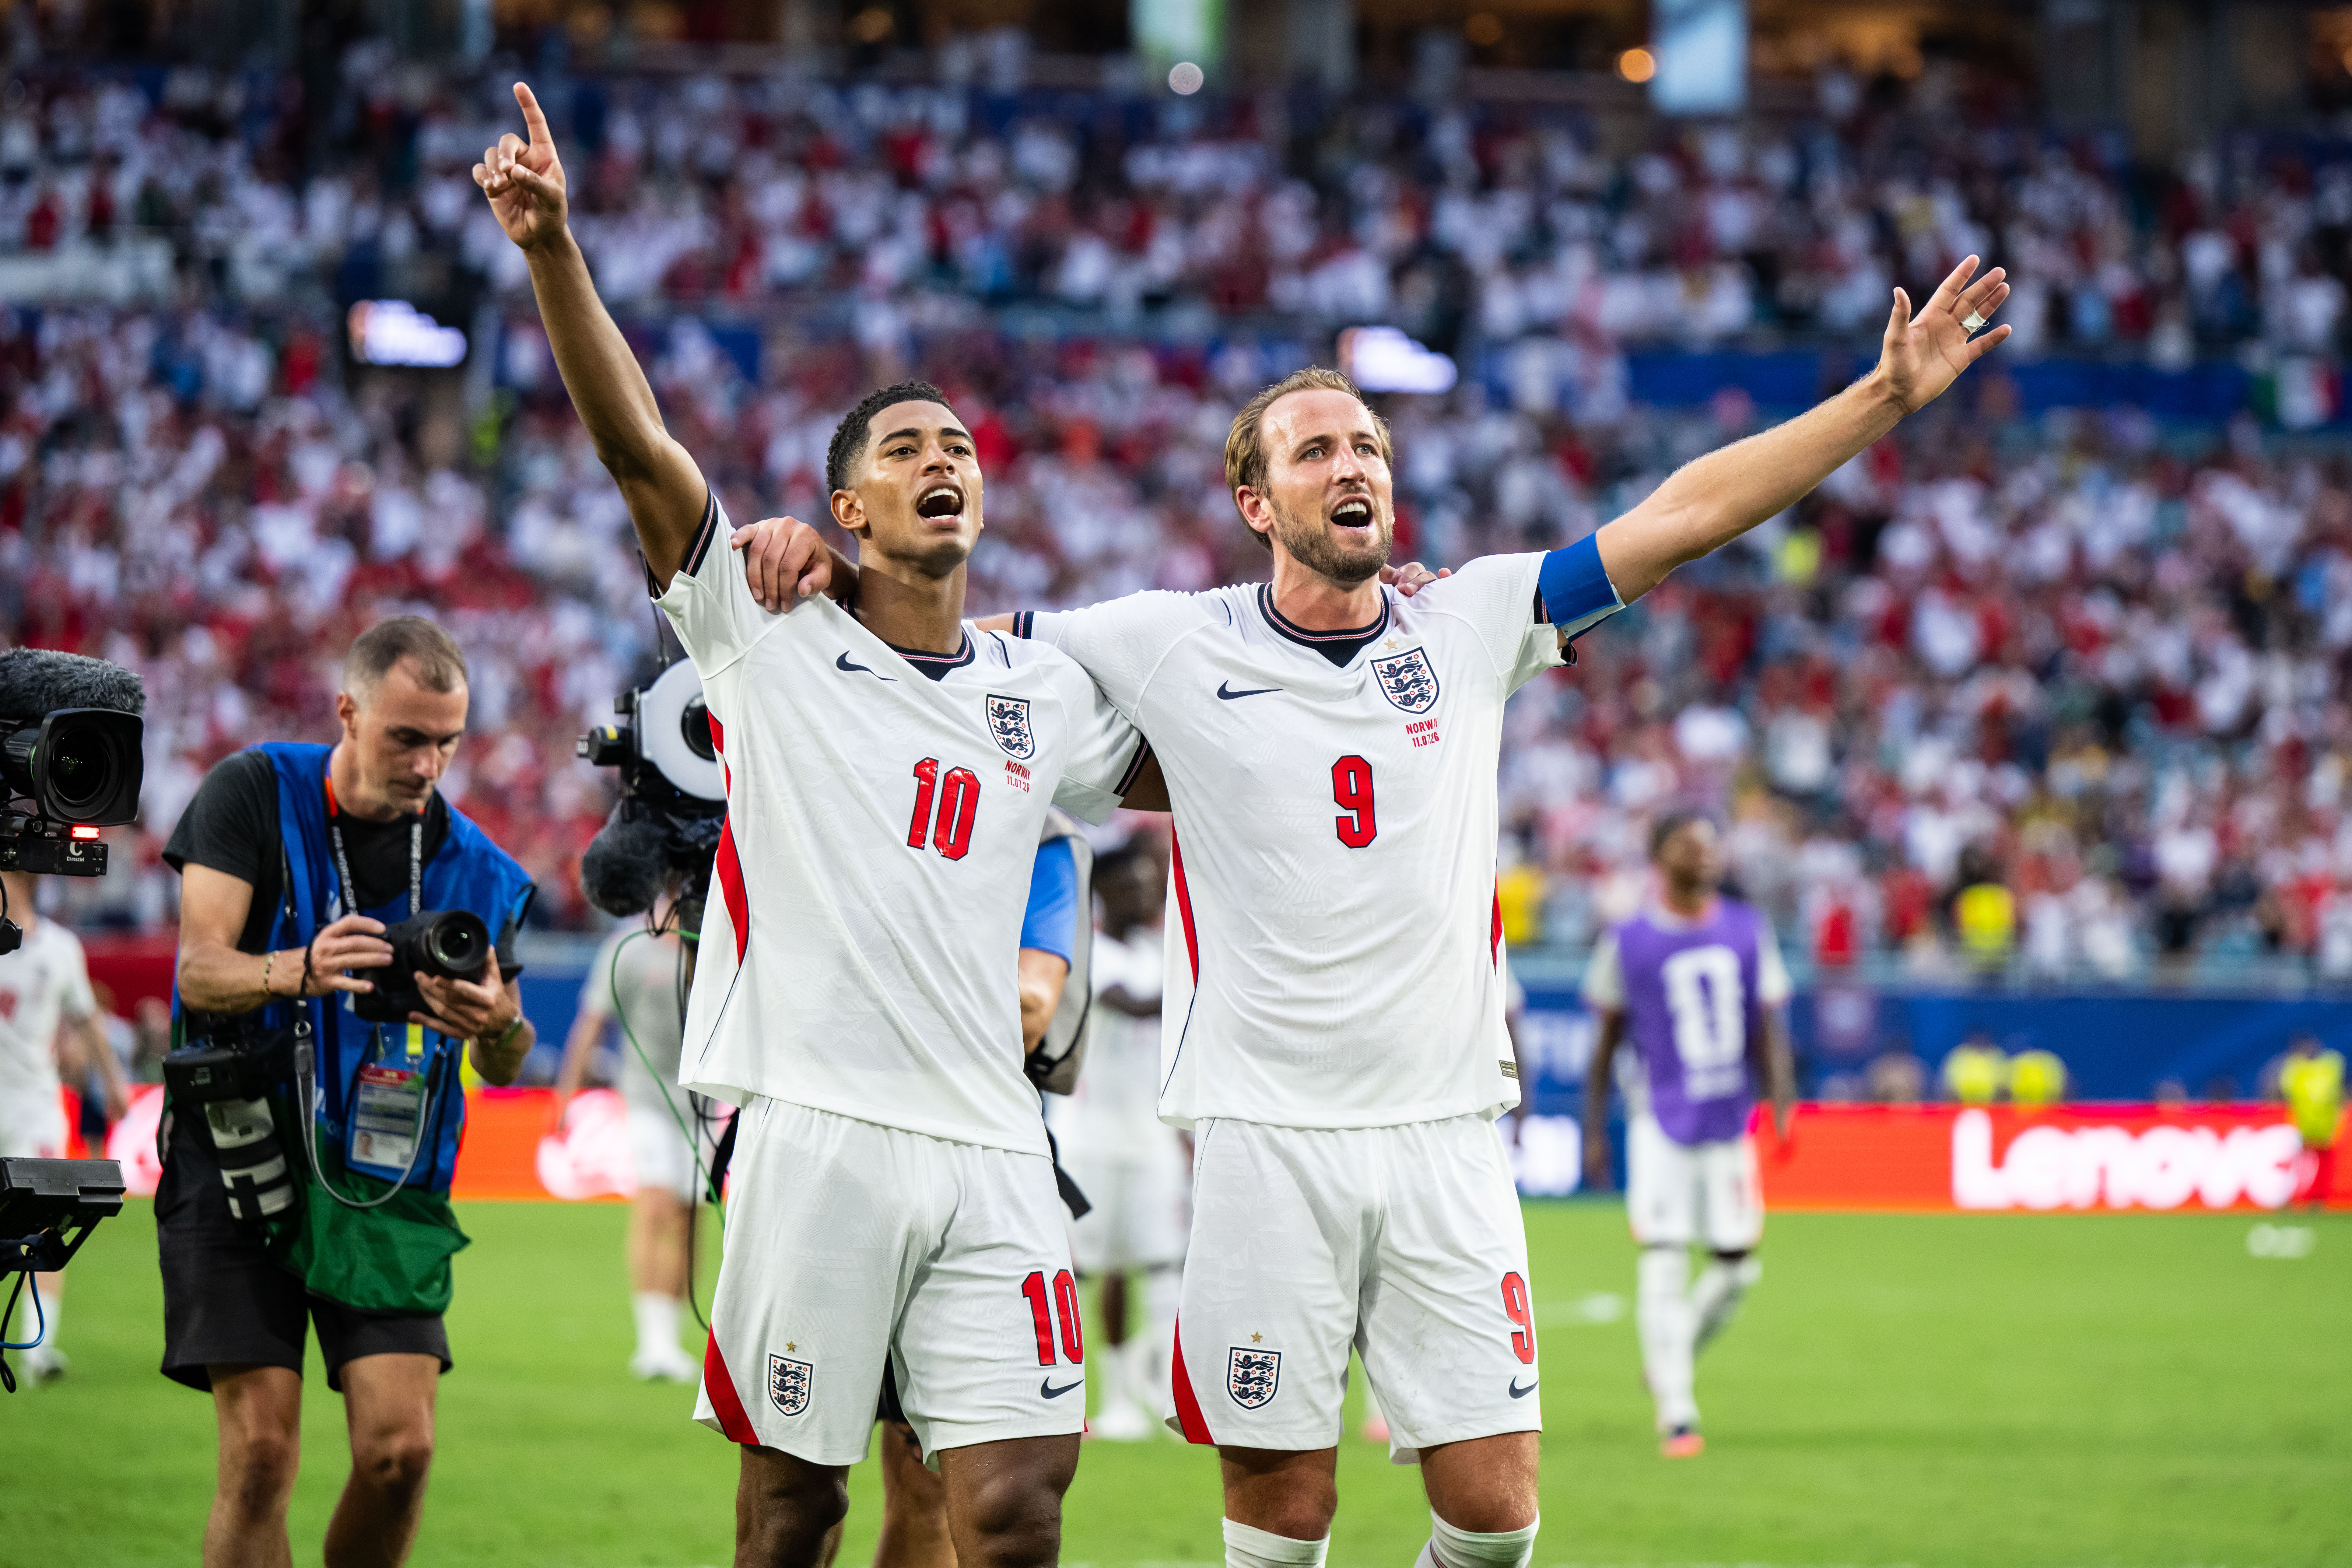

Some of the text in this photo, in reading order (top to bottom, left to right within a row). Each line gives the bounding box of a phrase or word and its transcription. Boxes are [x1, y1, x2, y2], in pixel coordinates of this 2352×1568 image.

[1005, 760, 1030, 780] NORWAY
[1007, 775, 1030, 793] 11.07.26
[1412, 732, 1439, 747] 11.07.26
[907, 757, 981, 861] 10
[1331, 755, 1377, 849] 9
[1021, 1269, 1083, 1366] 10
[1501, 1271, 1535, 1364] 9
